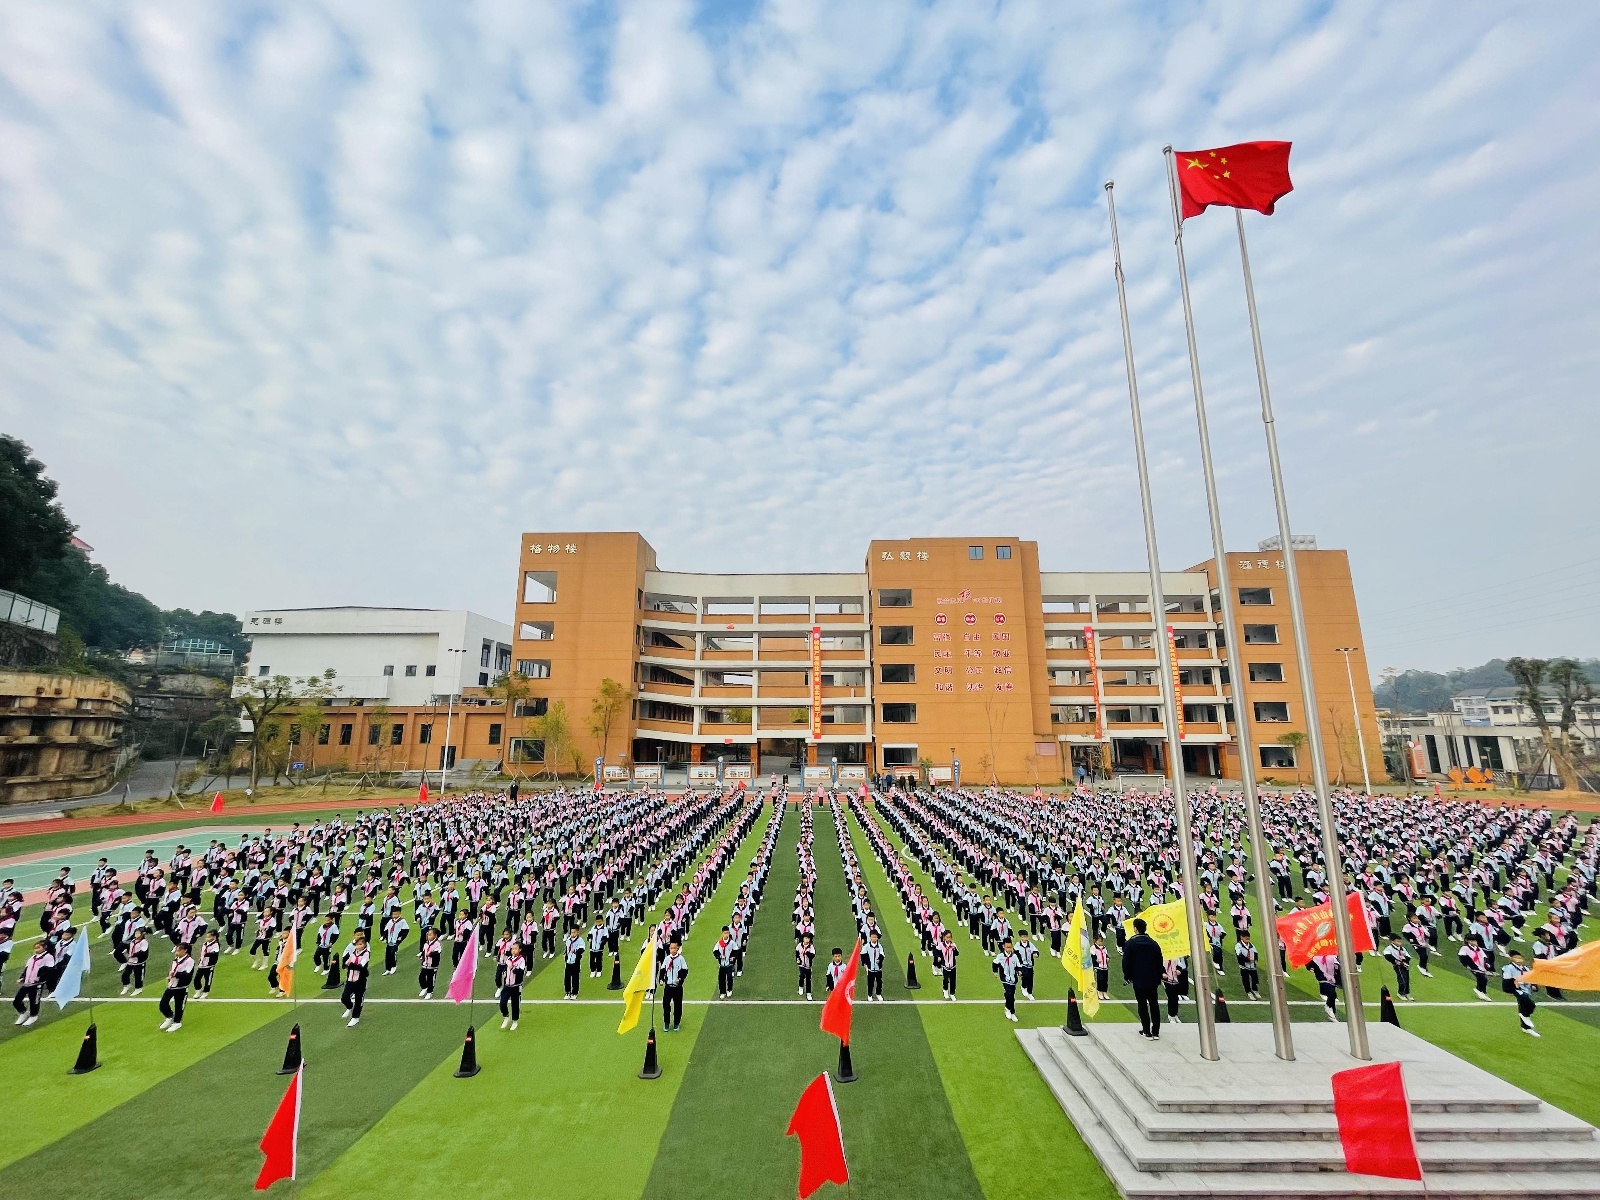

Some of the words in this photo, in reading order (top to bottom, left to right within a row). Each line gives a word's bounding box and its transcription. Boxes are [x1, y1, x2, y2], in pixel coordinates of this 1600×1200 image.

[529, 543, 578, 554] 格物楼
[881, 550, 929, 561] 弘毅楼
[963, 632, 981, 642] 自由
[992, 632, 1010, 642] 爱国
[934, 649, 952, 659] 民主
[964, 649, 982, 659] 平等
[992, 649, 1011, 659] 敬业
[934, 666, 953, 676] 文明
[966, 666, 983, 675] 公正
[993, 665, 1012, 675] 诚信
[935, 682, 953, 692] 和谐
[995, 682, 1014, 692] 友善
